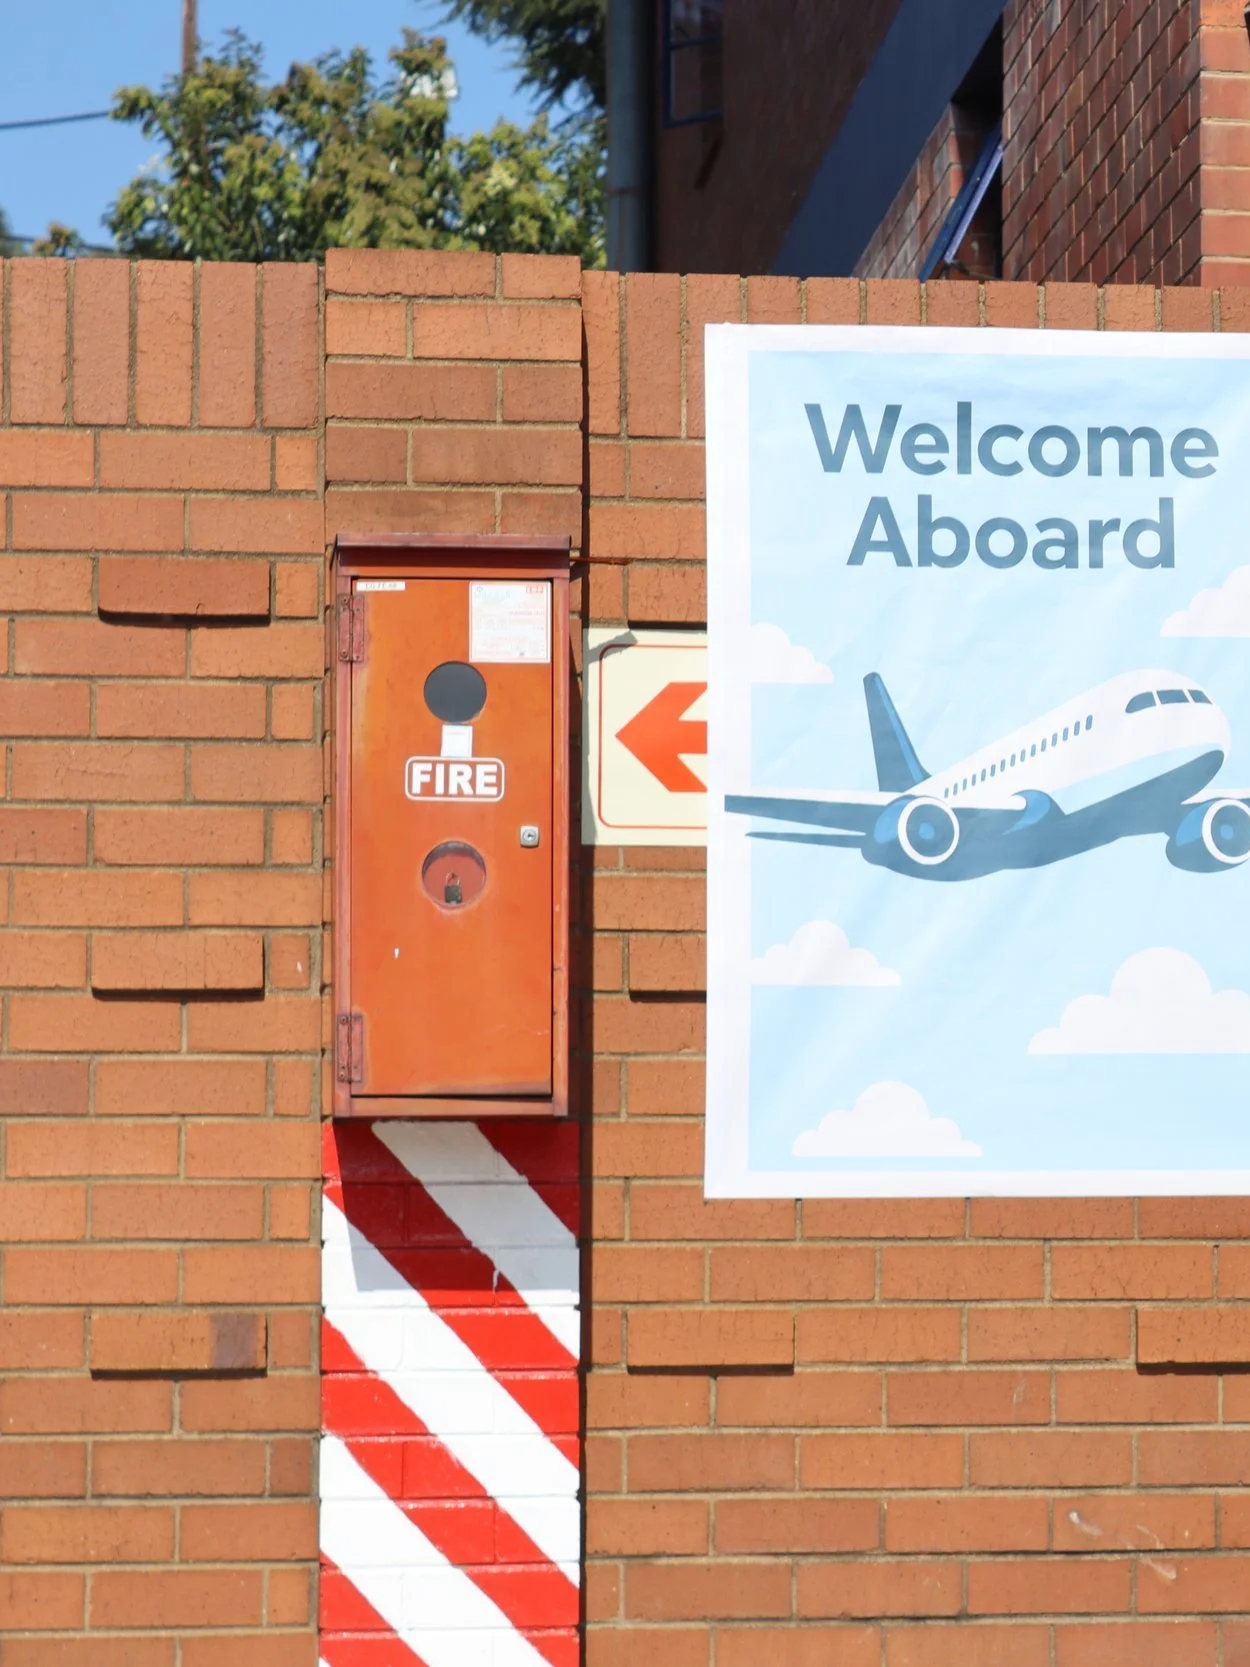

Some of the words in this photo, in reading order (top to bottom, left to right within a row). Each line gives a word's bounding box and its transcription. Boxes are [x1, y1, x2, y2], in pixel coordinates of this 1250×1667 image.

[804, 401, 1219, 479] Welcome
[846, 494, 1175, 570] Aboard
[411, 763, 498, 796] FIRE
